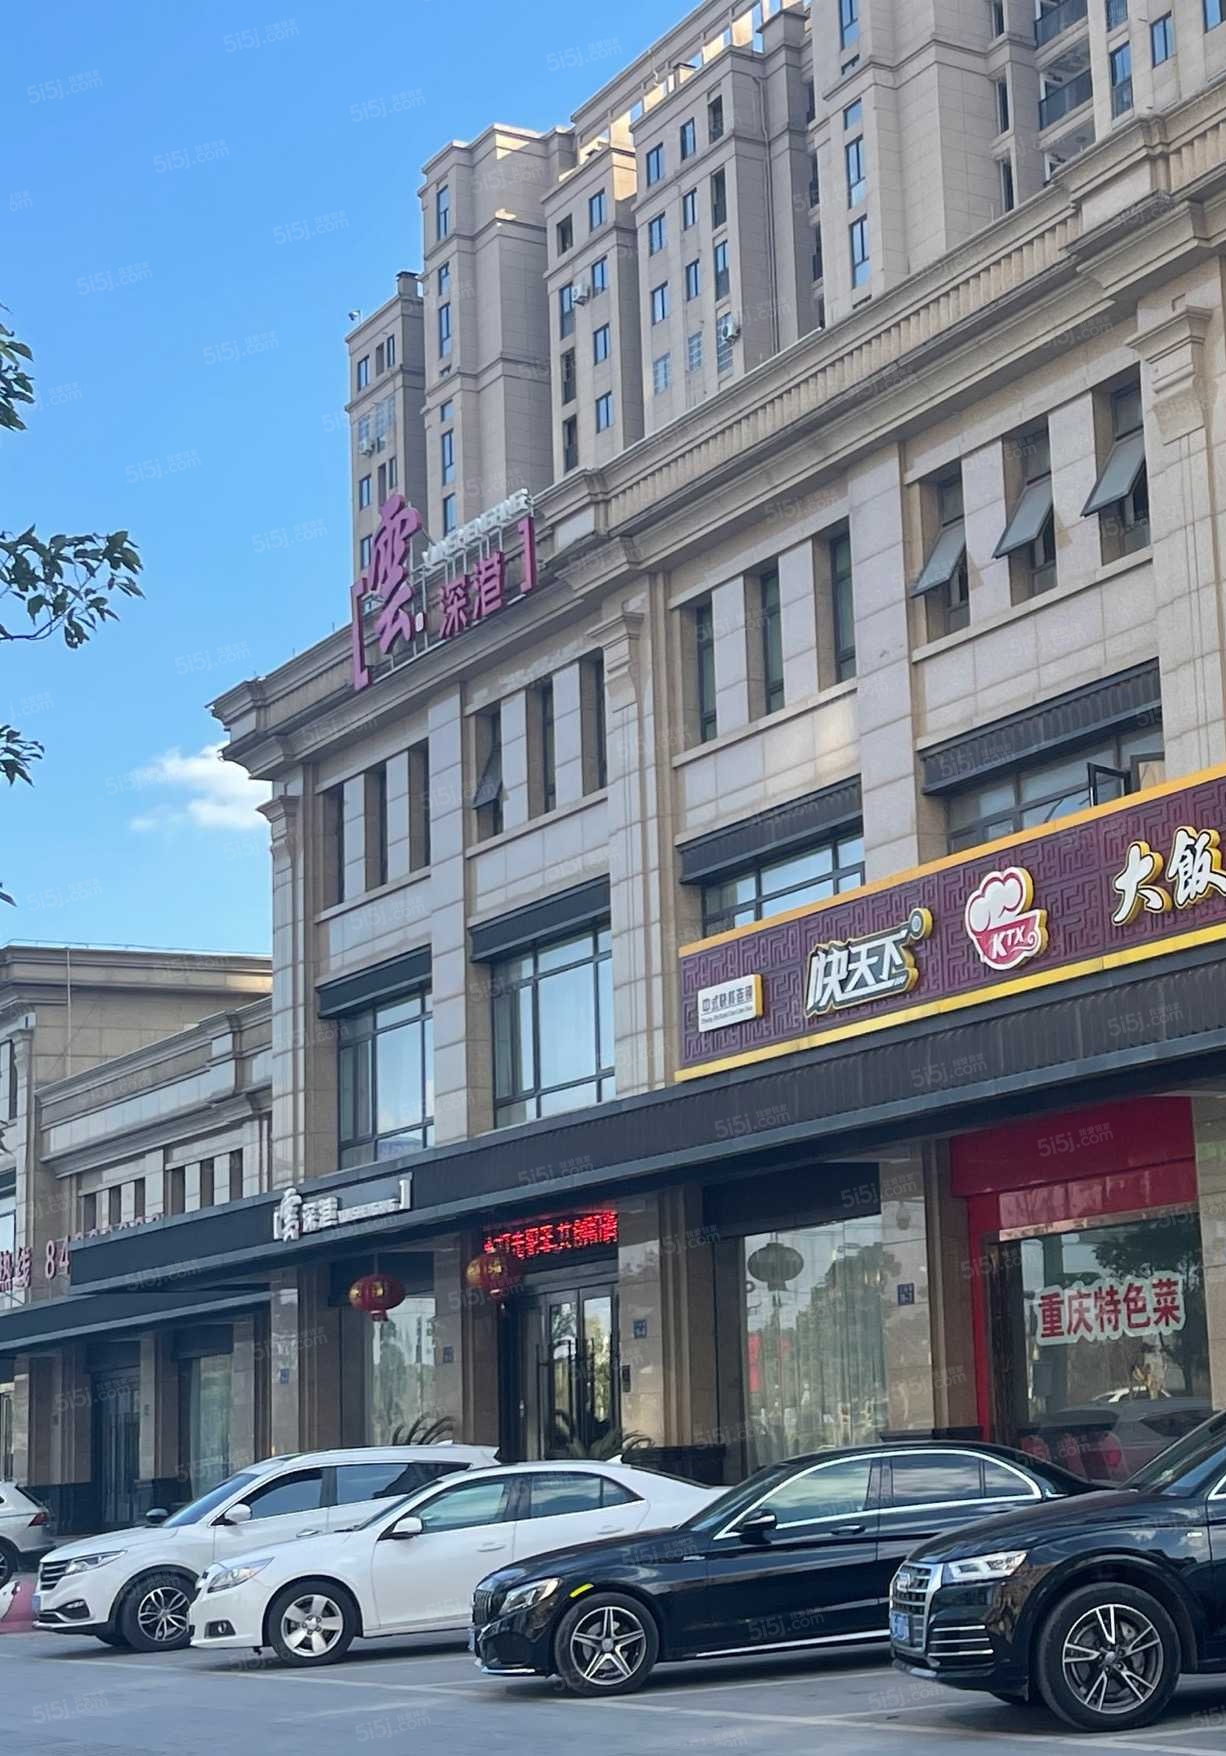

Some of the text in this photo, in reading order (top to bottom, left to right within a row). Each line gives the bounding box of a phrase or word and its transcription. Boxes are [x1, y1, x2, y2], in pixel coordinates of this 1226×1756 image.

[804, 928, 918, 1017] 快天下
[991, 925, 1025, 960] KTX
[1038, 1277, 1182, 1339] 重庆特色菜
